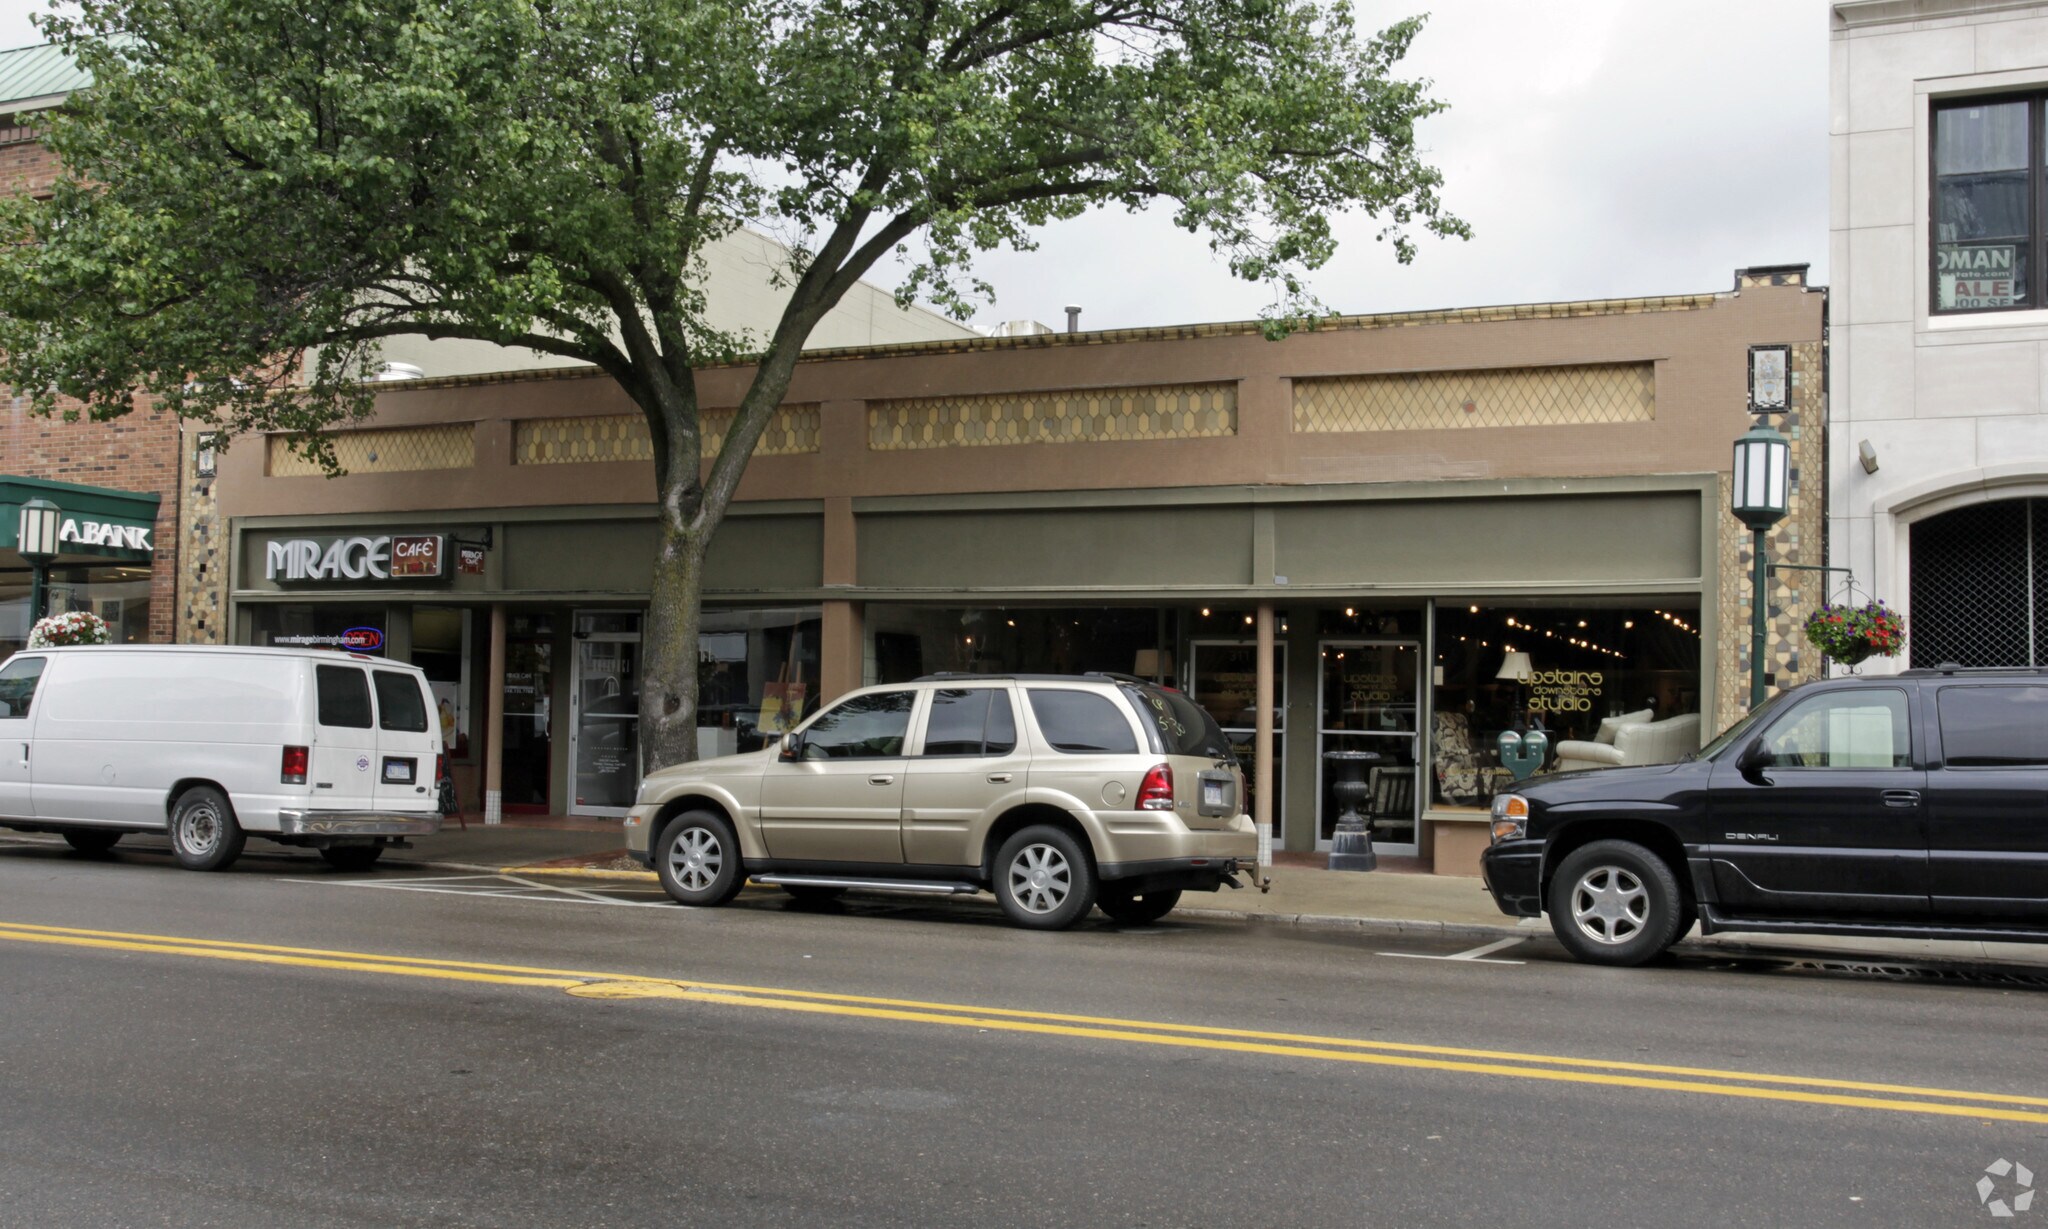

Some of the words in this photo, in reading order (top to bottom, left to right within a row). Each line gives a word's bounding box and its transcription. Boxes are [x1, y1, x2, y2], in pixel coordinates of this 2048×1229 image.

[1955, 281, 2010, 297] ALE
[59, 518, 154, 551] ABANK
[266, 536, 390, 579] MIRAGE
[274, 634, 365, 645] www.miragebirmingham.com
[1517, 669, 1603, 687] upstairs
[1533, 685, 1602, 696] downstairs
[1528, 695, 1591, 711] studio
[1725, 832, 1779, 841] DENALI
